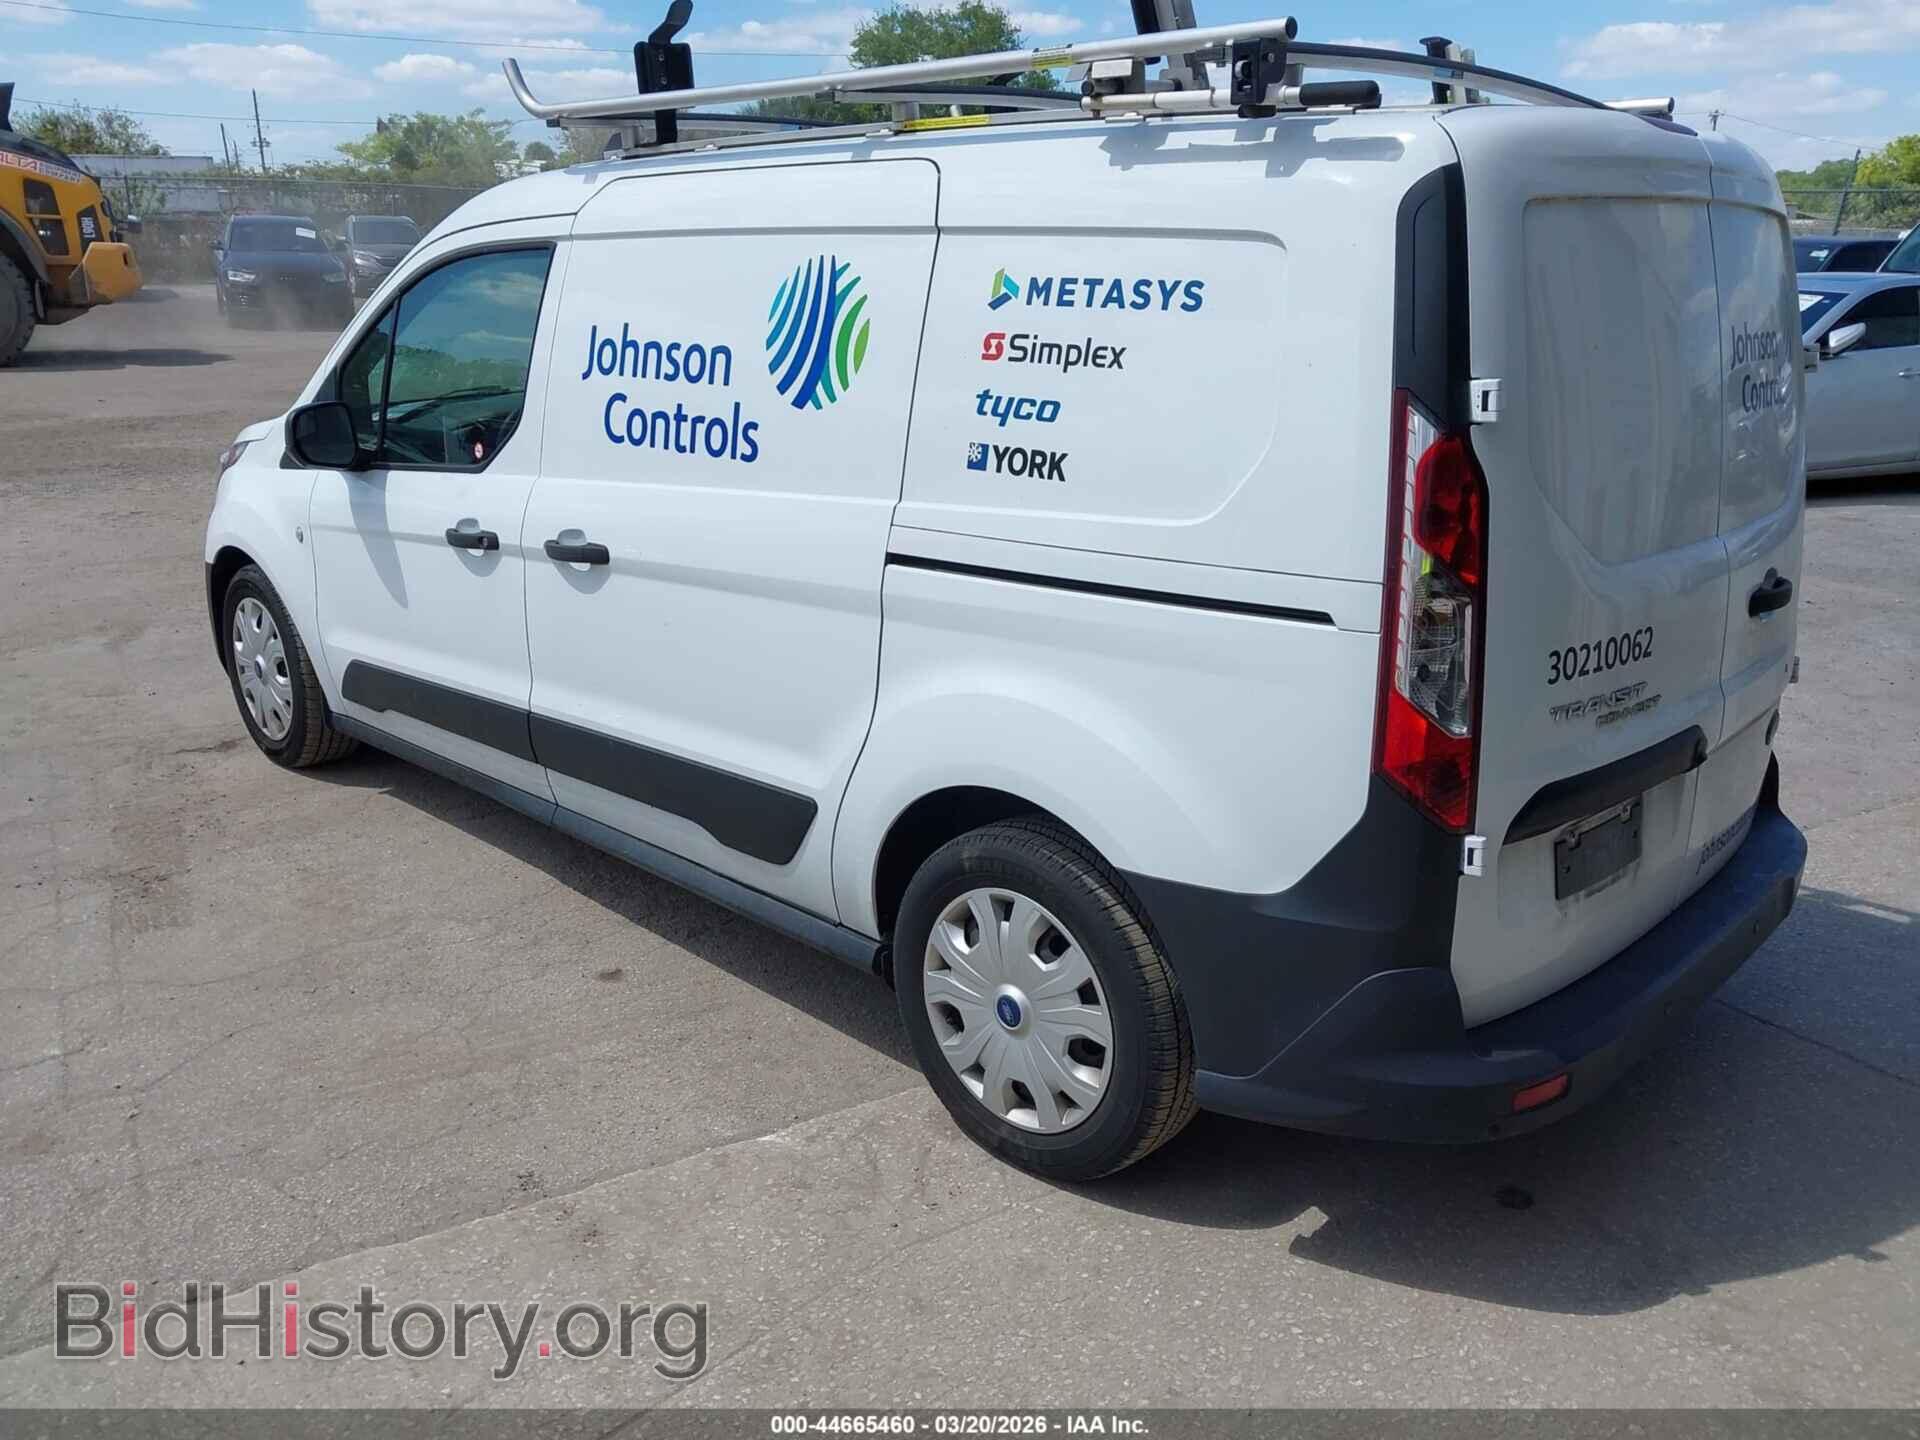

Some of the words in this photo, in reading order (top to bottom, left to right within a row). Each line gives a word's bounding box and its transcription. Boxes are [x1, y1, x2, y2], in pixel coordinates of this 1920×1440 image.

[1026, 276, 1205, 312] METASYS
[581, 322, 732, 386] Johnson
[1008, 333, 1127, 373] Simplex
[1730, 321, 1778, 370] Johnson
[604, 392, 759, 463] Controls
[975, 388, 1062, 427] tyco
[992, 444, 1069, 482] YORK
[1547, 626, 1654, 686] 30210062
